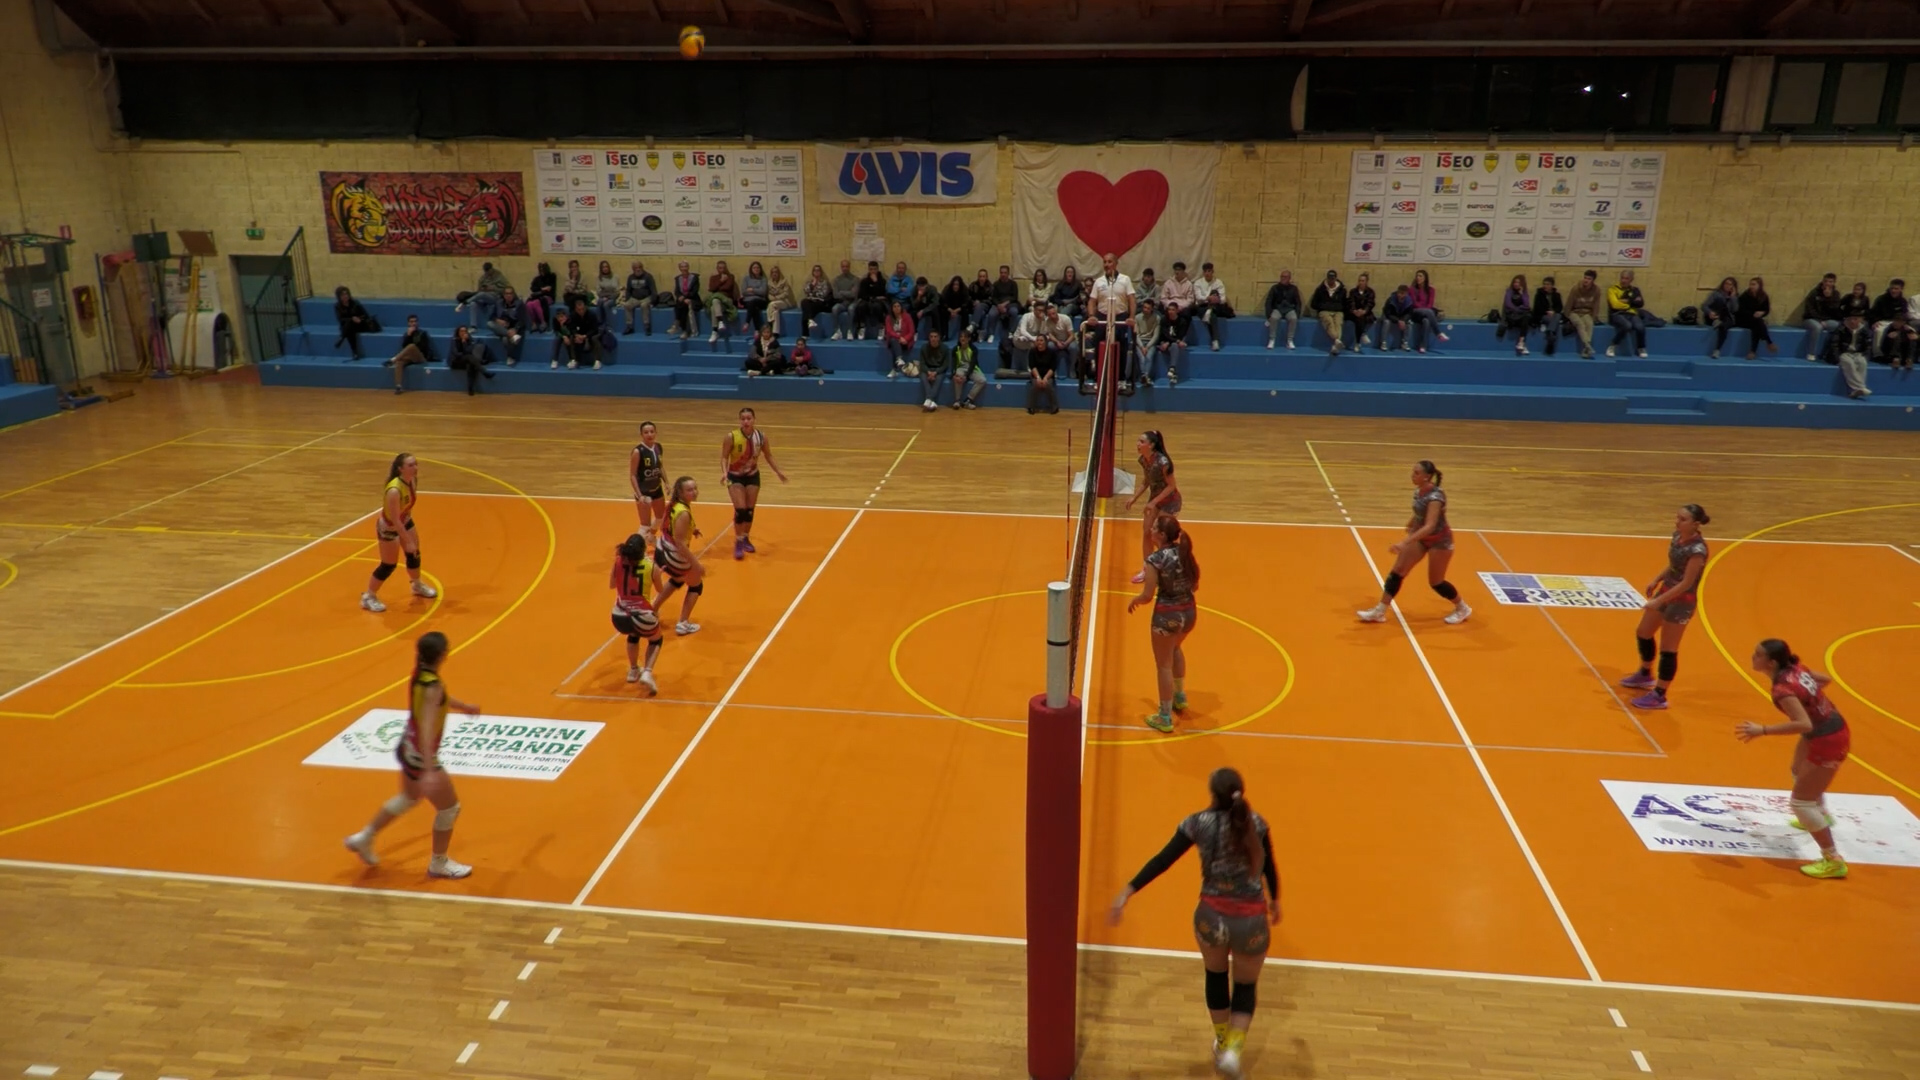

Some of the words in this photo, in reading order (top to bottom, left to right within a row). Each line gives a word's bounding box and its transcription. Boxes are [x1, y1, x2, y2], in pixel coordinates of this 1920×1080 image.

[606, 151, 638, 166] ISEO
[692, 151, 725, 166] ISEO
[1395, 156, 1421, 167] ASSA
[1436, 153, 1474, 168] ISEO
[1537, 153, 1576, 168] ISEO
[839, 151, 974, 197] AVIS
[675, 176, 696, 187] ASSA
[1512, 179, 1538, 191] ASSA
[574, 195, 596, 206] ASSA
[1391, 201, 1416, 212] ASSA
[776, 239, 798, 249] ASSA
[1617, 248, 1643, 259] ASSA
[623, 564, 645, 596] 15
[1548, 589, 1633, 601] servizi
[1555, 598, 1642, 608] sistemi
[452, 722, 586, 741] SANDRINI
[439, 735, 583, 757] SERRANDE
